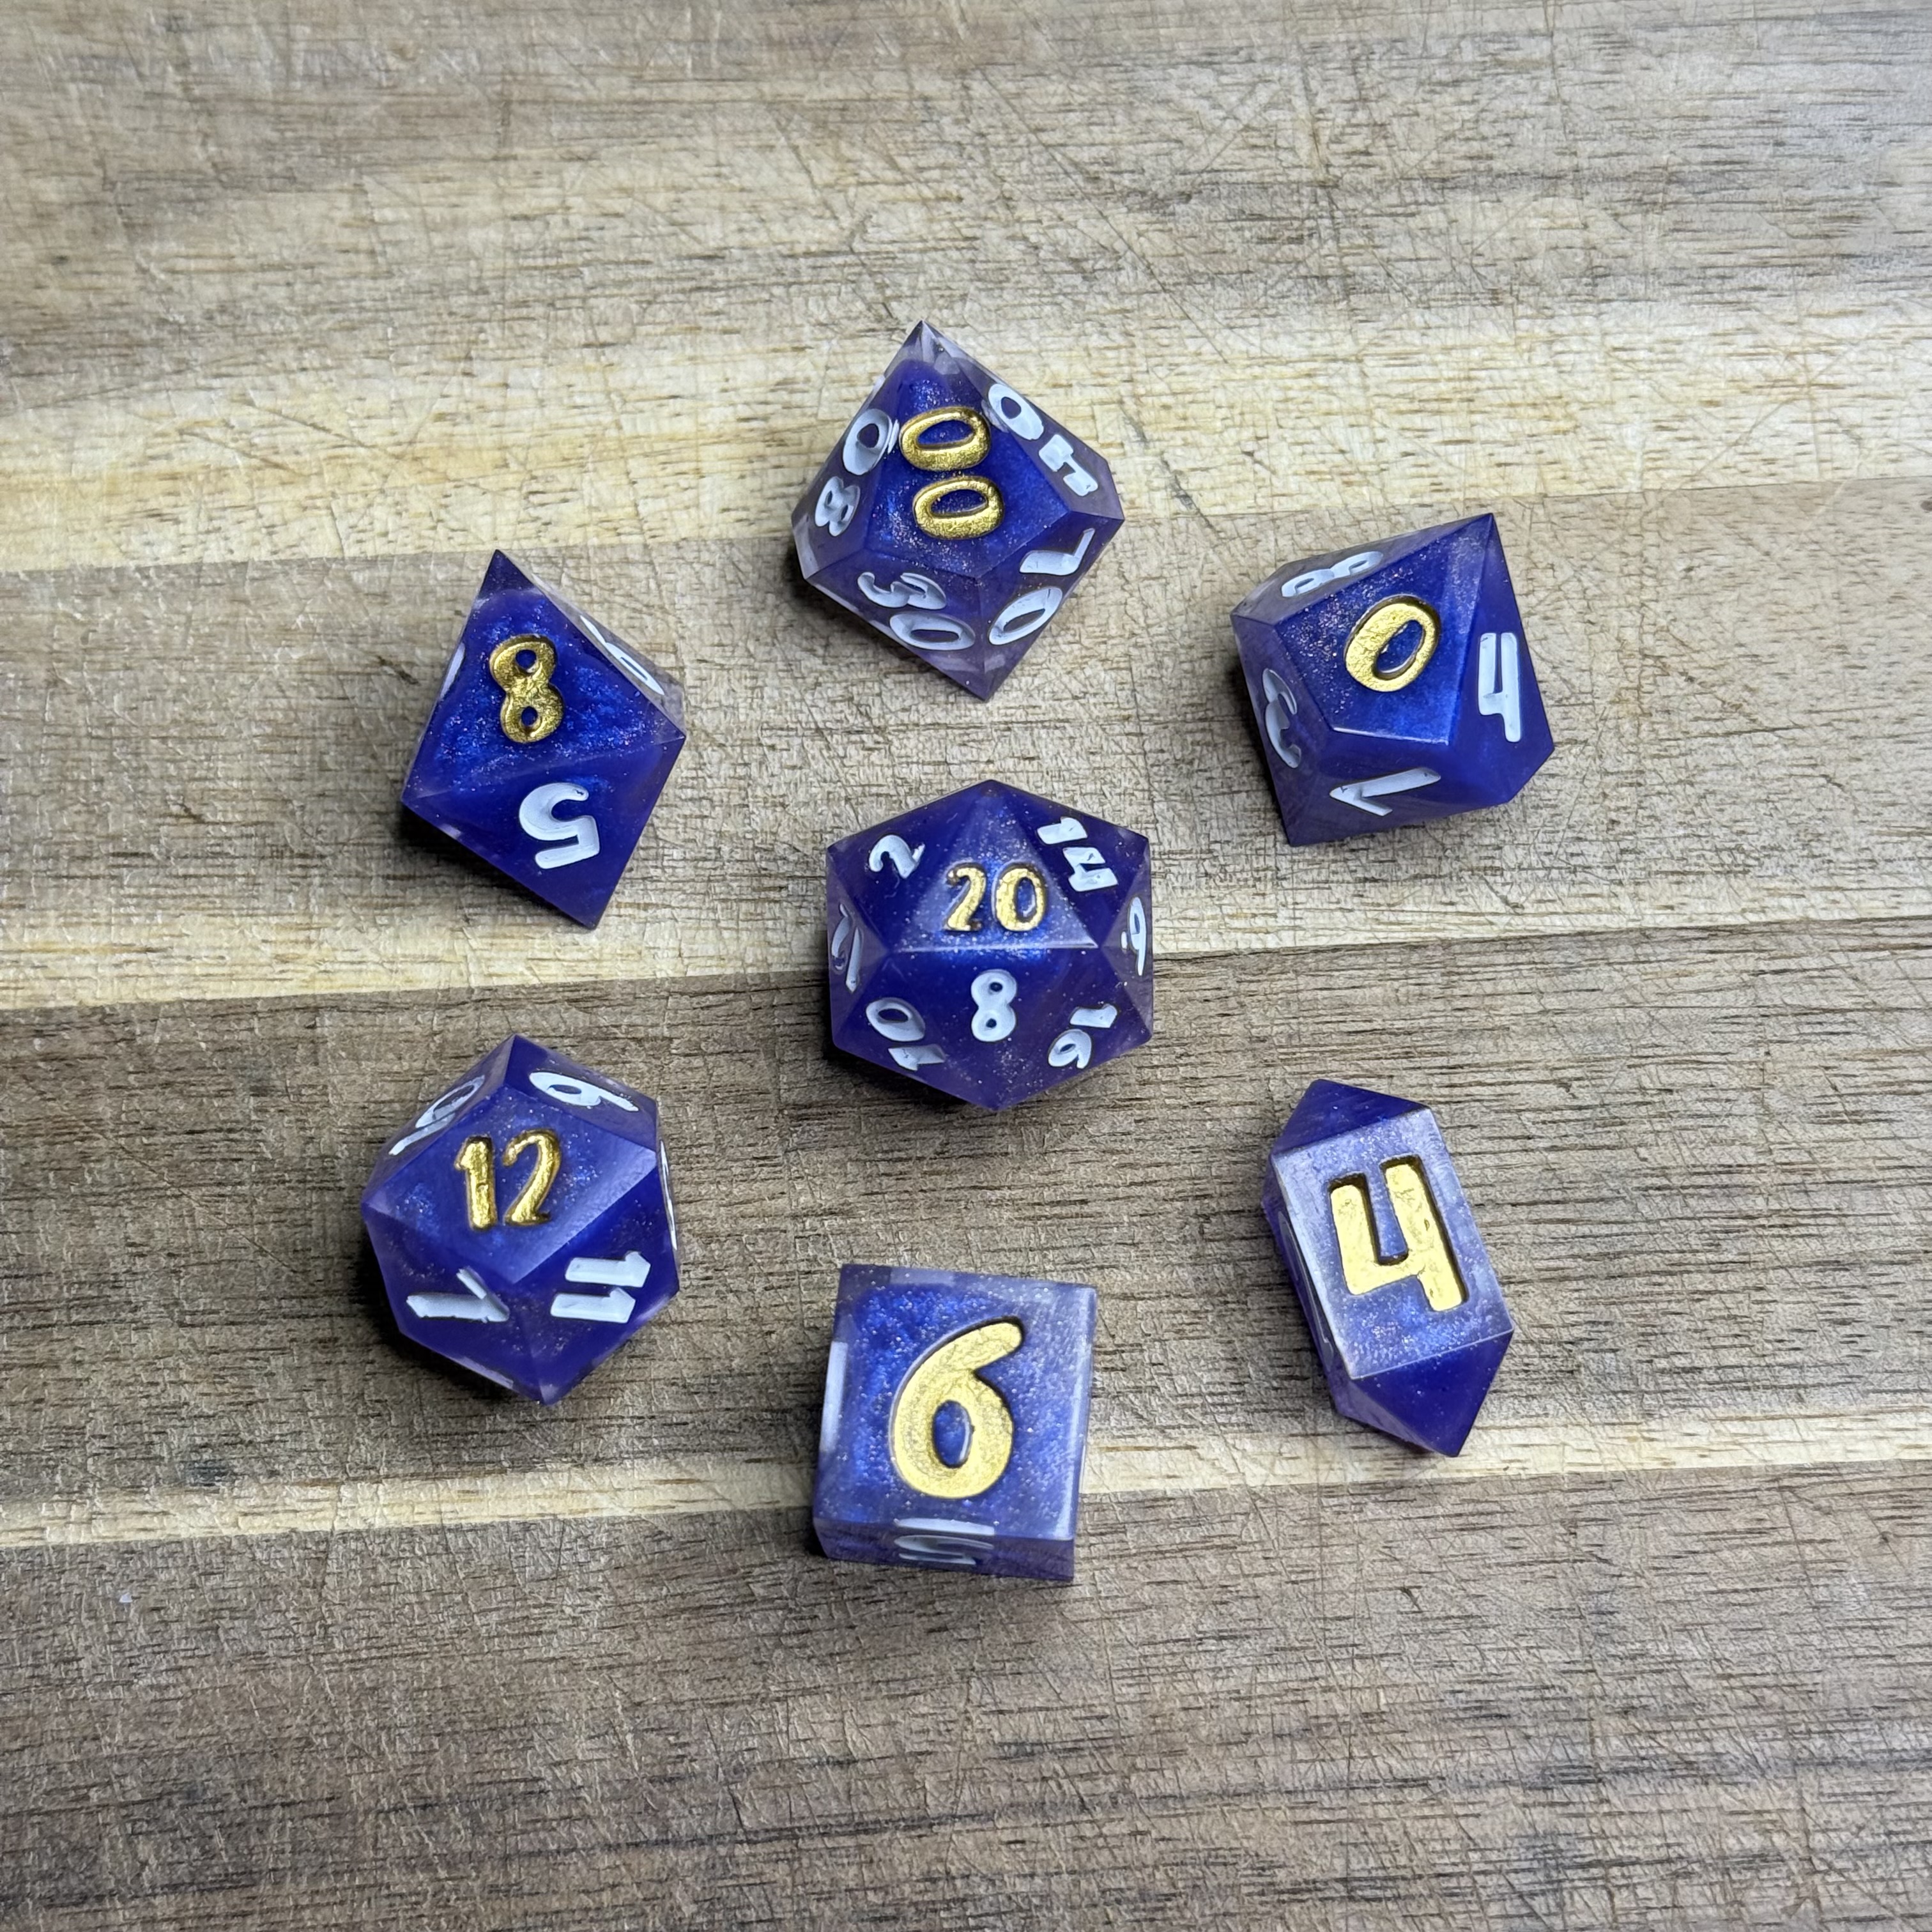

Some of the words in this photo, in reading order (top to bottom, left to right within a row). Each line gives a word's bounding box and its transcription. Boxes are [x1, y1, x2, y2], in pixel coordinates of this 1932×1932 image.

[898, 405, 1004, 540] 00
[1281, 551, 1383, 597] 8
[489, 634, 564, 744] 8
[1344, 594, 1441, 692] 0
[1478, 632, 1521, 742] 4
[1262, 668, 1301, 769] 3
[519, 782, 601, 870] 5
[869, 834, 925, 879] 2
[1037, 816, 1119, 892] 14
[944, 861, 1047, 932] 20
[970, 969, 1017, 1042] 8
[455, 1128, 561, 1232] 12
[1326, 1154, 1468, 1312] 4
[550, 1250, 651, 1324] 11
[889, 1315, 1026, 1498] 6
